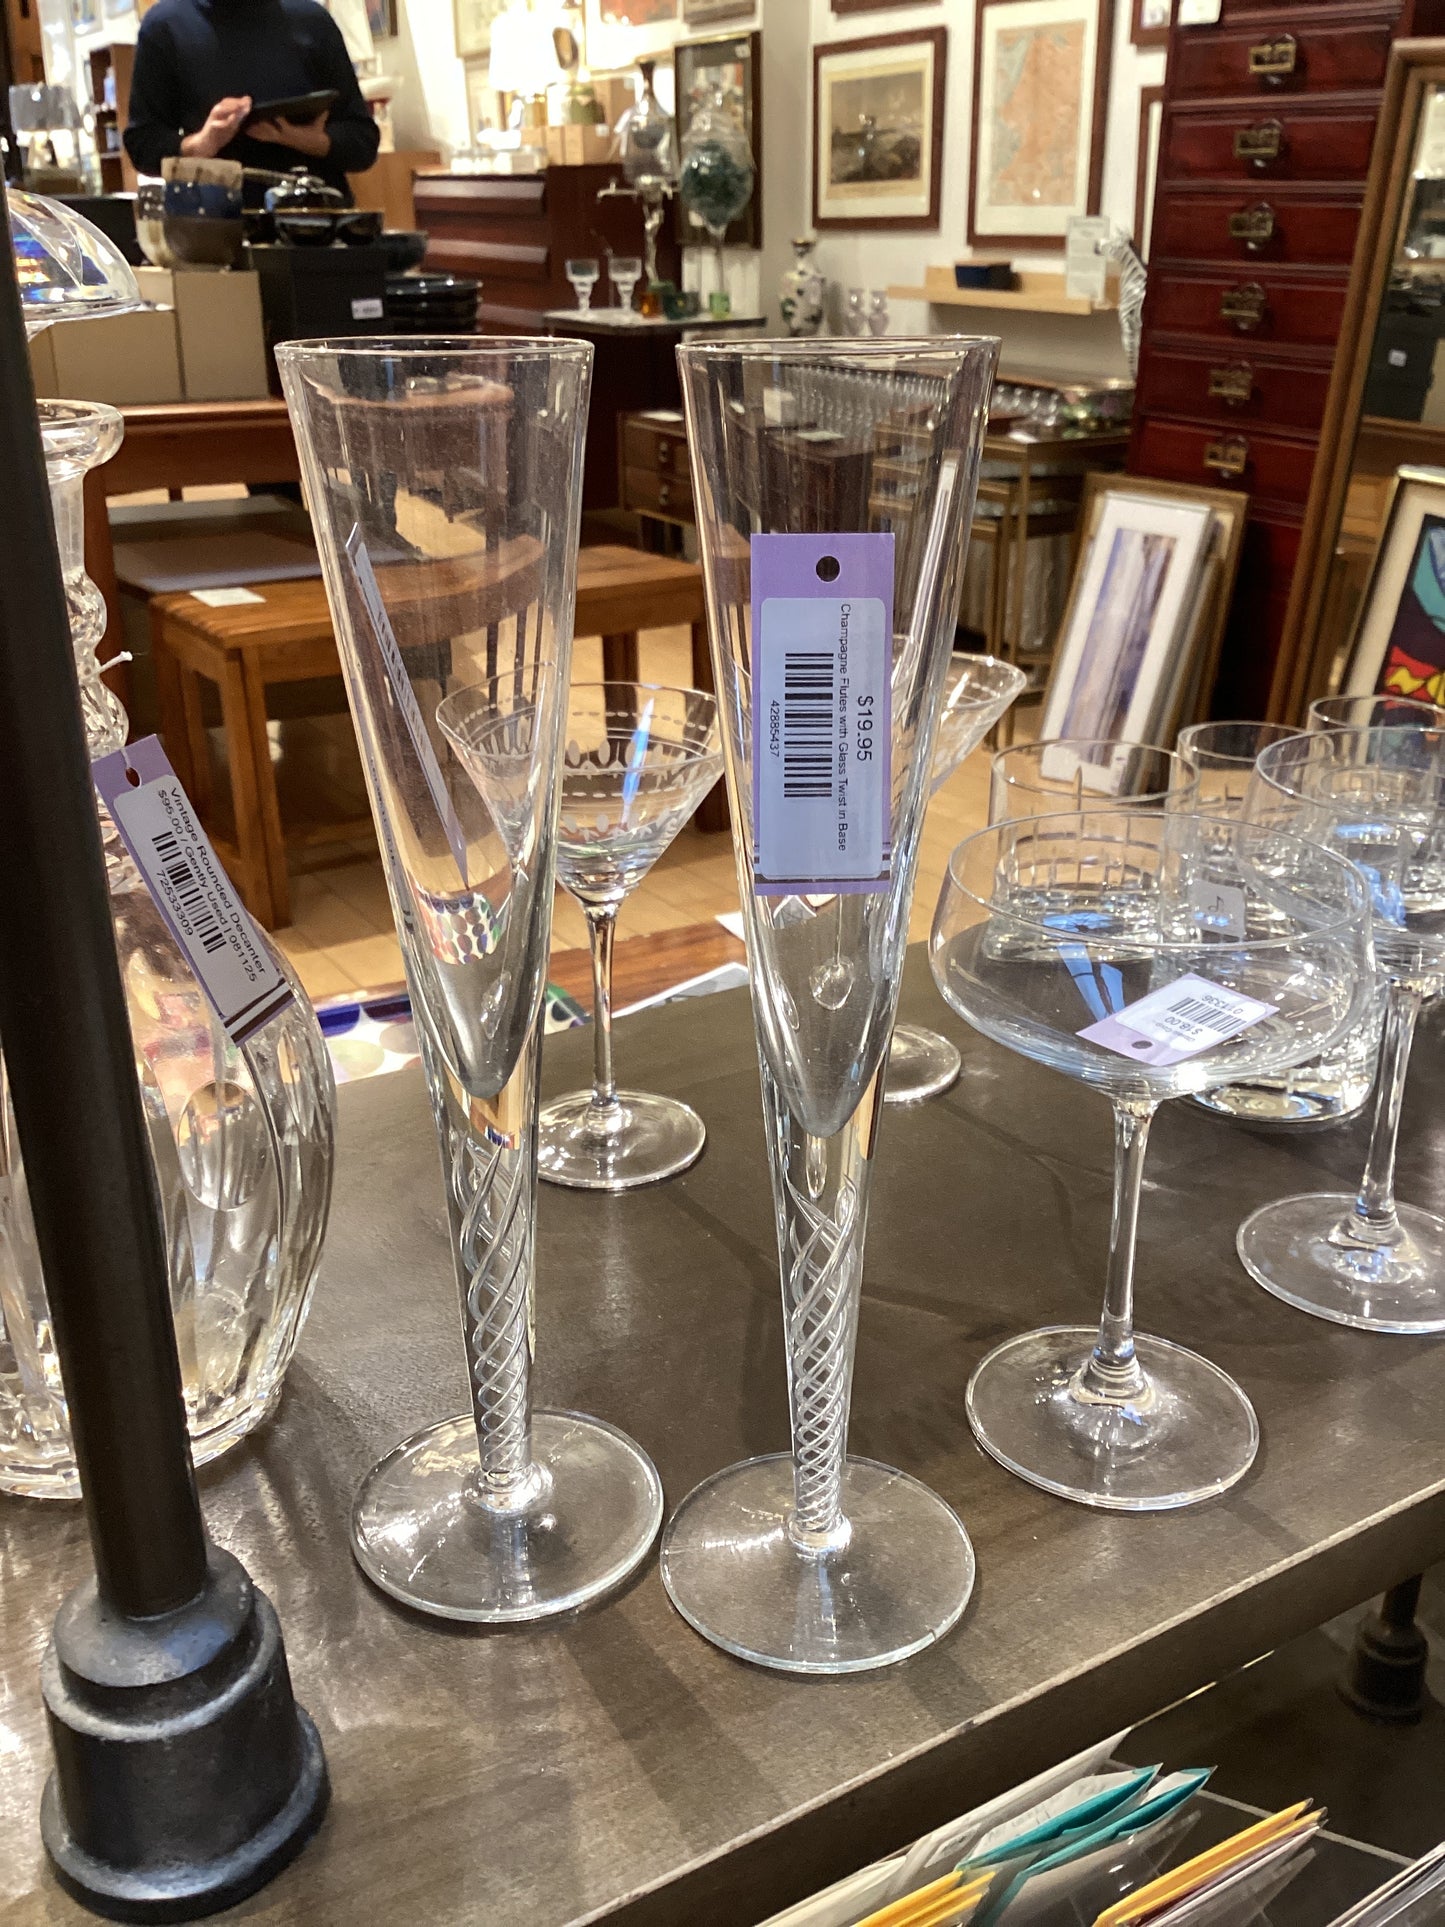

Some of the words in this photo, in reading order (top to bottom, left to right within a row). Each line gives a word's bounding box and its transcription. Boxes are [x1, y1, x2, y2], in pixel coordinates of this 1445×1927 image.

[838, 603, 851, 674] Champagne
[839, 677, 850, 711] Flutes
[769, 699, 780, 757] 42885437
[839, 714, 848, 738] with
[856, 695, 873, 761] $19.95
[839, 742, 849, 776] Glass
[839, 778, 848, 807] Twist
[839, 809, 848, 820] in
[838, 823, 848, 851] Base
[158, 788, 183, 835] $95.00
[185, 845, 209, 888] Gently
[207, 891, 227, 926] Used
[229, 935, 257, 982] 081125
[171, 787, 198, 843] Vintage
[196, 845, 233, 909] Rounded
[229, 911, 266, 974] Decanter
[156, 869, 193, 936] 72533309
[1202, 995, 1243, 1014] 011336
[1164, 1017, 1203, 1036] $18.00
